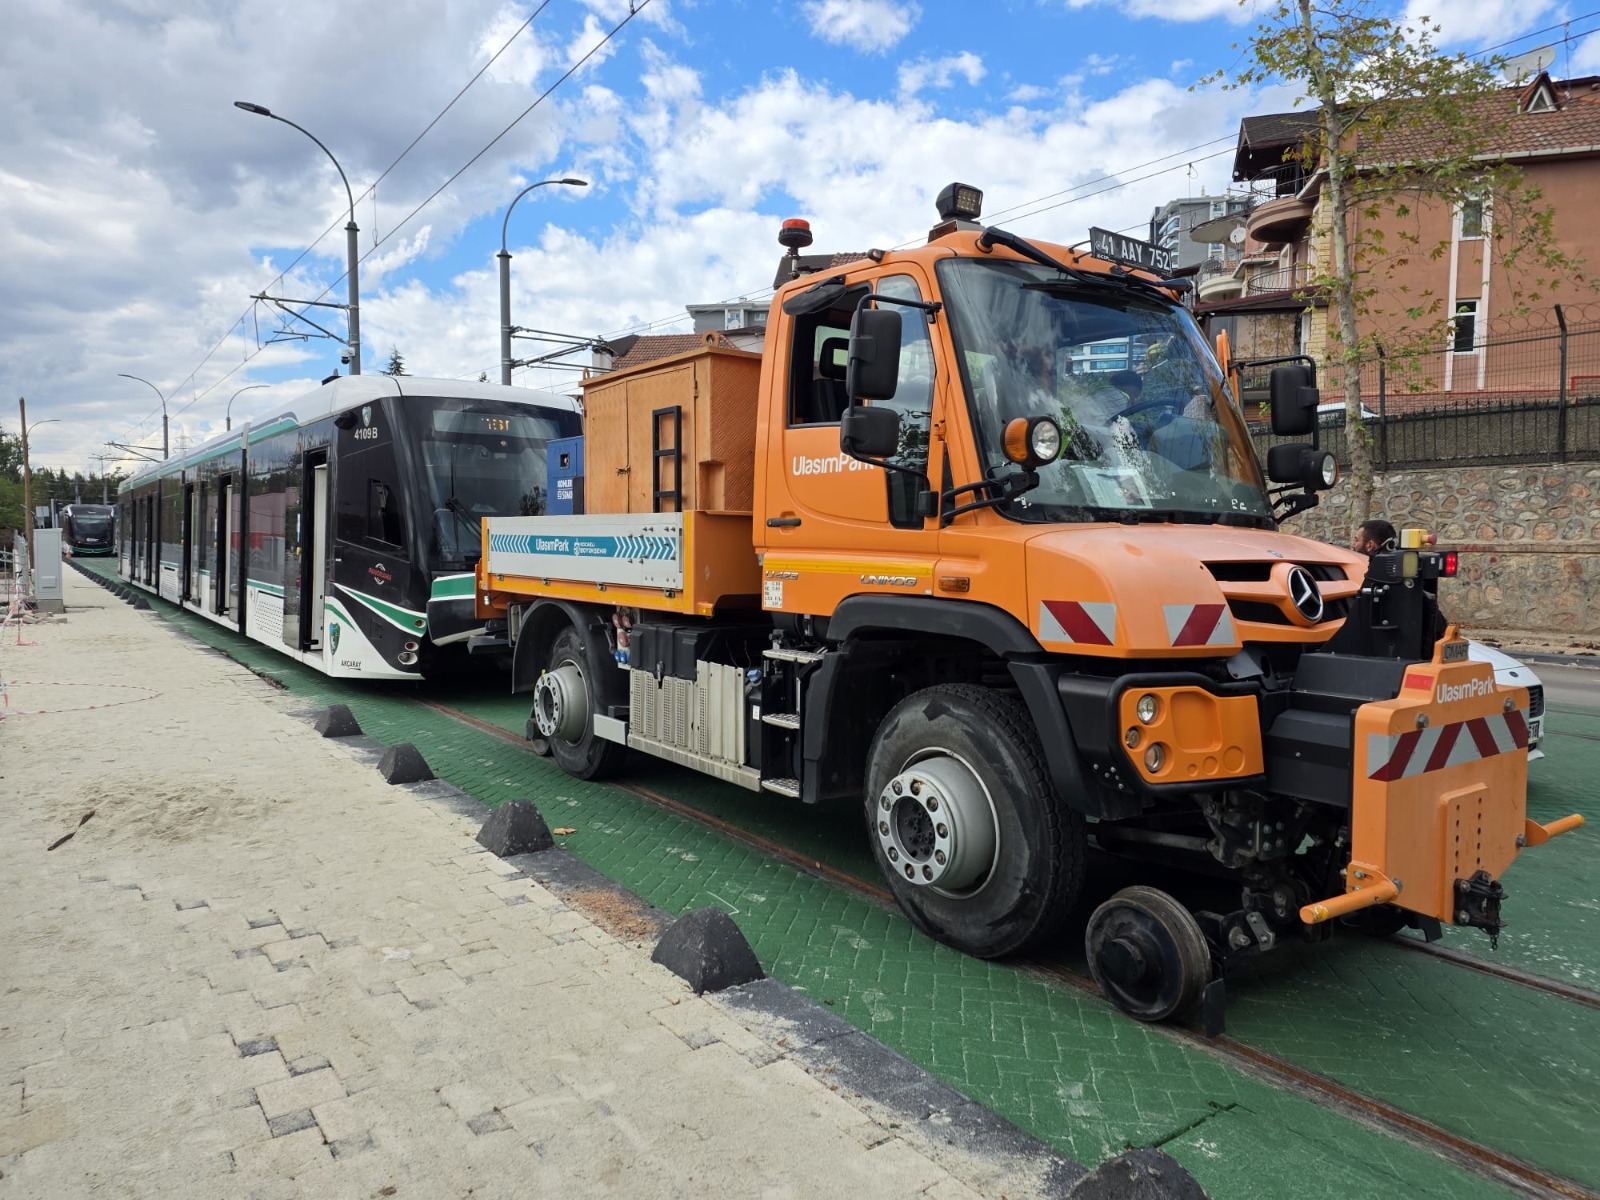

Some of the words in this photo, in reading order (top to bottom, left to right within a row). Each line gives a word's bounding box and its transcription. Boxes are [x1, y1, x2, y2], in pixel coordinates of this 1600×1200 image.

[1101, 234, 1114, 255] 41
[1121, 239, 1142, 263] AAY
[1149, 247, 1170, 271] 752
[860, 574, 917, 587] UNIMOG
